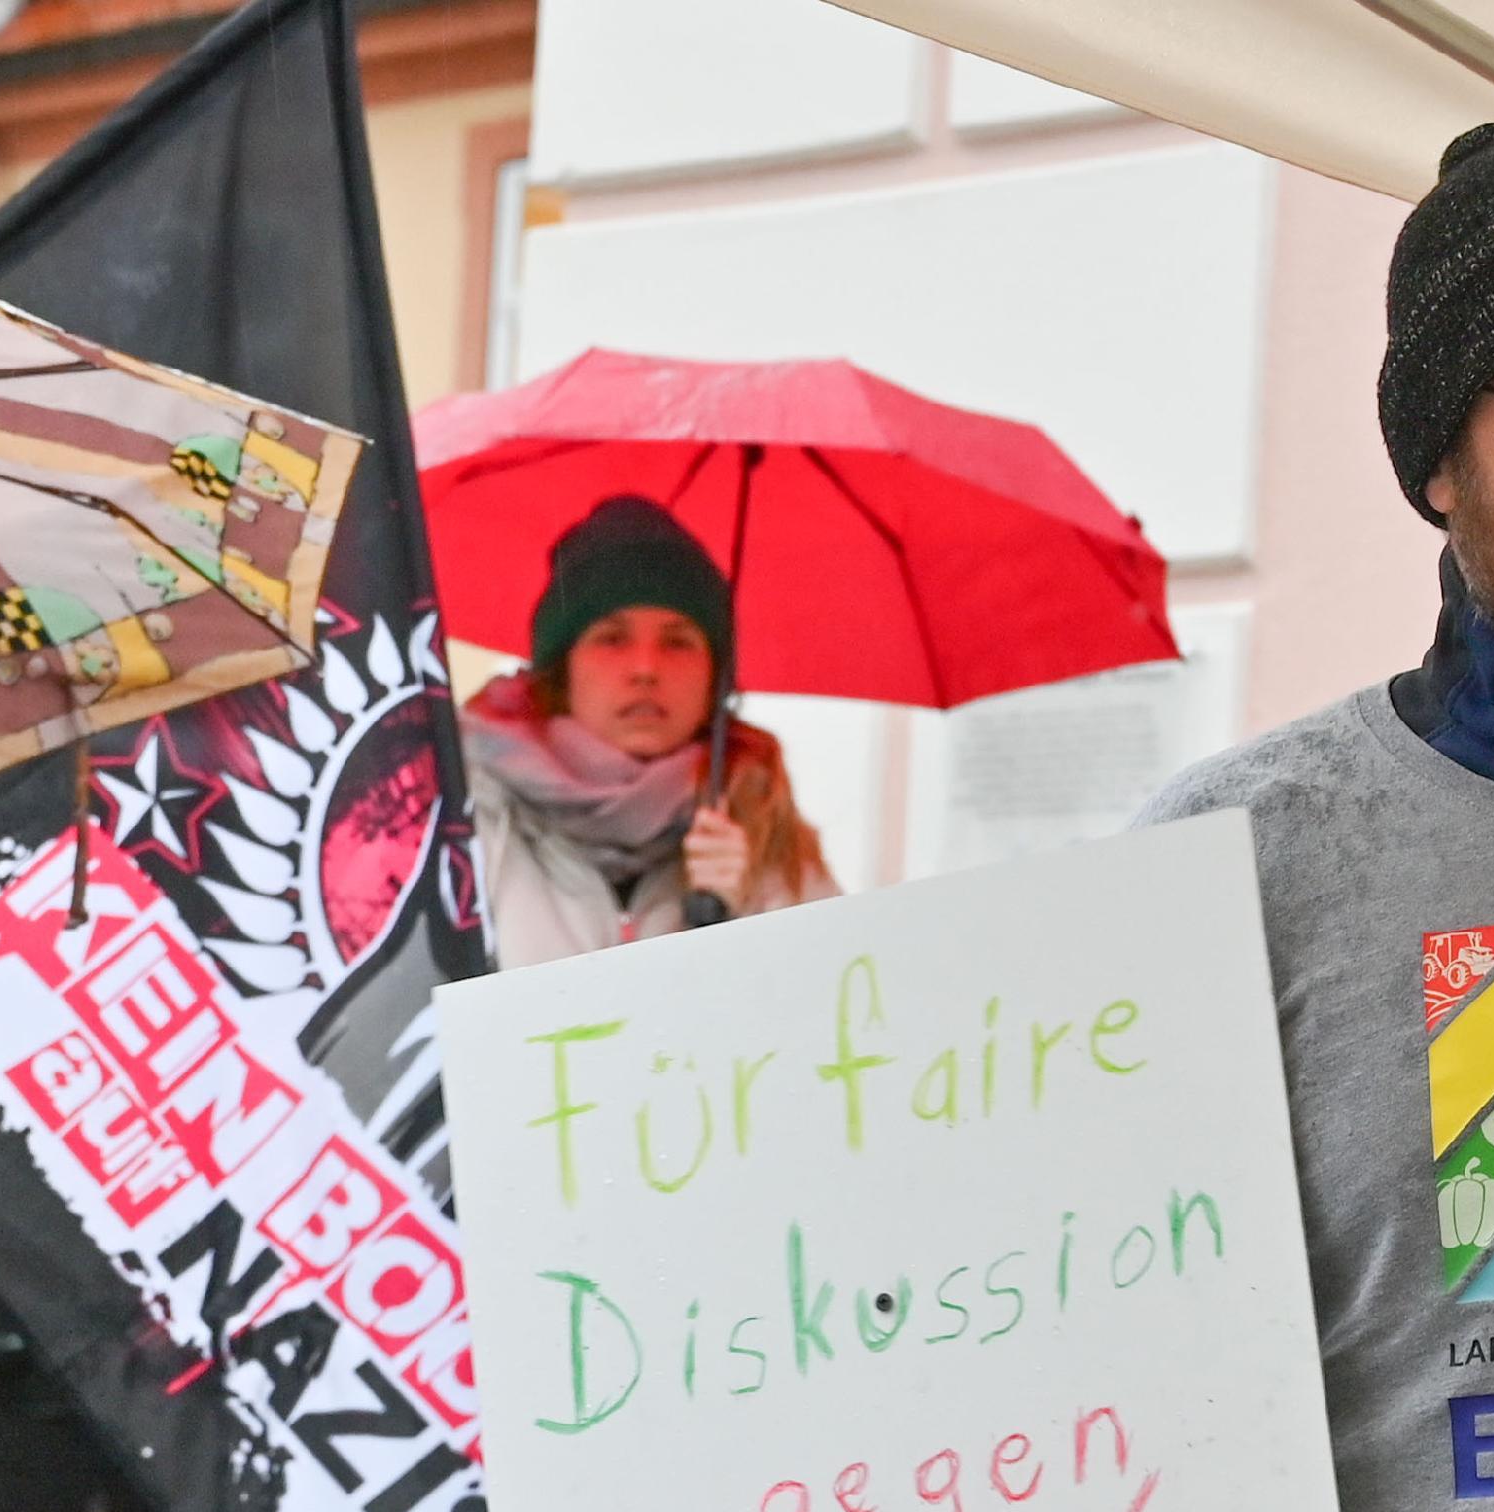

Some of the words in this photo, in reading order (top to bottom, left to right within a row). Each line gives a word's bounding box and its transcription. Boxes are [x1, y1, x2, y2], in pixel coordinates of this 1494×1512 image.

[2, 828, 305, 1182] KEIN
[525, 1018, 780, 1208] Für
[816, 954, 1146, 1152] faire
[536, 1187, 1226, 1434] Diskussion
